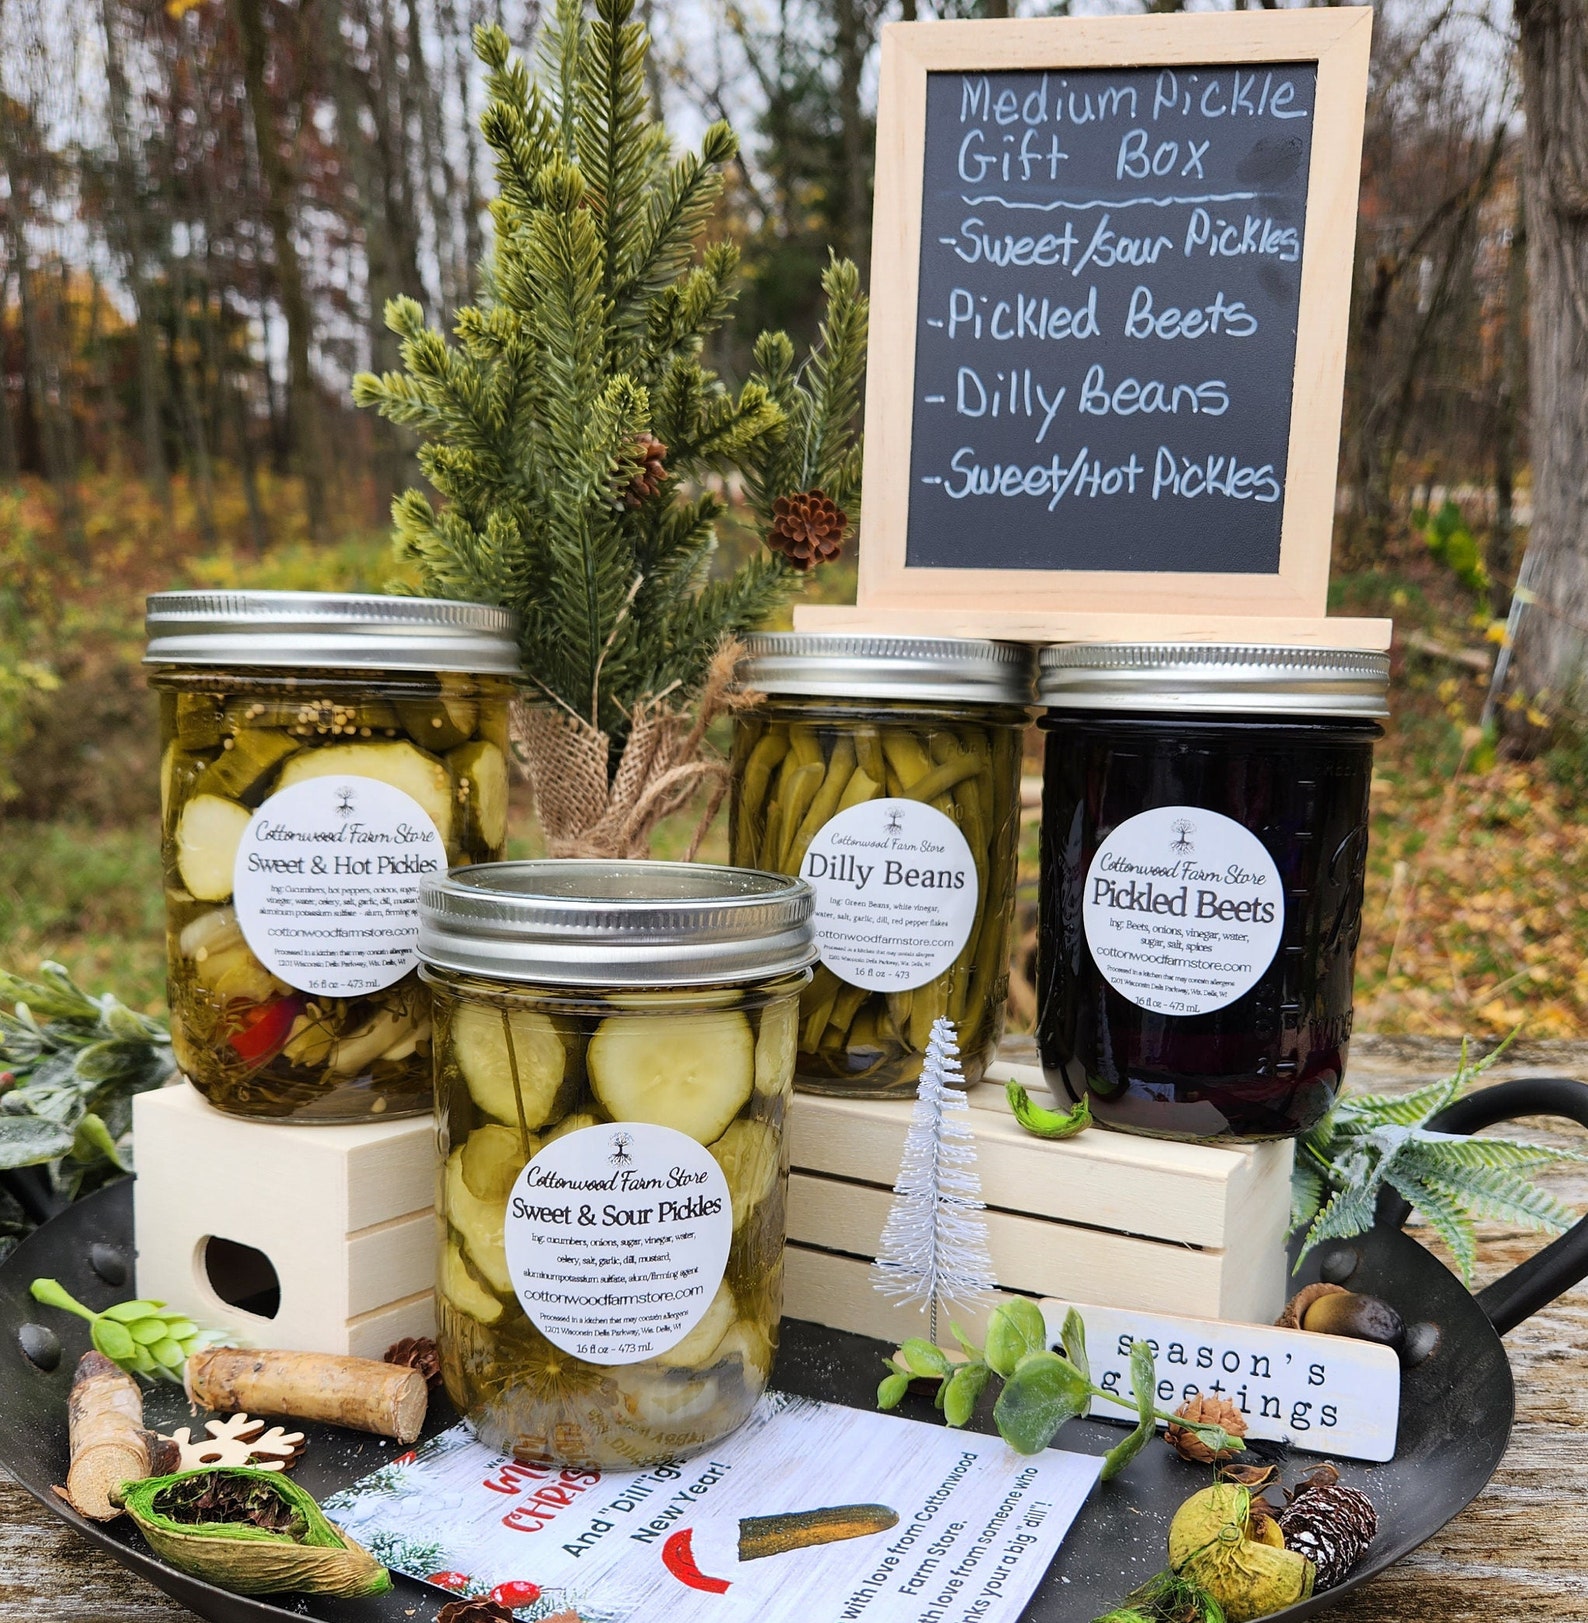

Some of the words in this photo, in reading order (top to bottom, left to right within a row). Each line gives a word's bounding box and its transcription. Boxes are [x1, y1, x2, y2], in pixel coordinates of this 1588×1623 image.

[960, 73, 1137, 125] Medium
[1153, 69, 1308, 121] Pickle
[958, 128, 1070, 184] Gift
[1116, 128, 1210, 181] Box
[1184, 208, 1299, 263] Pickles
[1124, 285, 1258, 340] Beets
[1078, 364, 1230, 416] Beans
[1152, 446, 1281, 502] Pickles
[255, 820, 349, 843] Cottonwood
[349, 823, 393, 844] Farm
[394, 823, 435, 844] Store
[831, 832, 890, 850] Cottonwood
[891, 838, 918, 852] Farm
[919, 840, 945, 854] Store
[248, 852, 304, 874] Sweet
[310, 855, 328, 875] &
[334, 856, 372, 875] Hot
[378, 854, 437, 875] Pickles
[807, 852, 875, 891] Dilly
[883, 860, 965, 890] Beans
[1100, 852, 1181, 878] Cottonwood
[1181, 860, 1223, 882] Farm
[1224, 864, 1266, 886] Store
[844, 898, 867, 908] Green
[868, 900, 892, 911] Beans,
[893, 901, 912, 911] white
[913, 903, 940, 914] vinegar,
[1092, 877, 1188, 917] Pickled
[1195, 889, 1275, 924] Beets
[267, 926, 420, 939] cottonwoodfarmstore.com
[837, 912, 851, 922] salt,
[853, 914, 875, 925] garlic,
[876, 915, 890, 926] dill,
[891, 916, 904, 926] red
[905, 918, 929, 928] pepper
[929, 917, 949, 928] flakes
[1126, 920, 1151, 932] Beets,
[1152, 924, 1184, 938] onions,
[1185, 928, 1221, 942] vinegar,
[1222, 932, 1250, 943] water,
[1140, 937, 1166, 949] sugar,
[1167, 938, 1184, 952] salt,
[1186, 942, 1212, 953] spices
[1096, 946, 1252, 973] cottonwoodfarmstore.com
[309, 980, 320, 989] 16
[347, 980, 364, 989] 473
[855, 968, 866, 977] 16
[876, 970, 886, 978] oz
[895, 970, 910, 980] 473
[1135, 996, 1145, 1006] 16
[1169, 1001, 1185, 1012] 473
[527, 1165, 619, 1192] Cottonwood
[621, 1169, 666, 1193] Farm
[666, 1166, 709, 1189] Store
[512, 1197, 573, 1225] Sweet
[577, 1204, 597, 1227] &
[602, 1205, 655, 1227] Sour
[658, 1195, 722, 1223] Pickles
[546, 1236, 588, 1248] cucumbers,
[590, 1237, 619, 1248] onions,
[679, 1266, 699, 1278] agent
[523, 1284, 704, 1307] cottonwoodfarmstore.com
[577, 1343, 588, 1354] 16
[598, 1345, 609, 1354] oz
[618, 1343, 636, 1354] 473
[638, 1342, 654, 1353] mL
[1100, 1370, 1338, 1431] geetings
[483, 1457, 506, 1470] We
[1013, 1467, 1039, 1496] who
[630, 1504, 685, 1544] New
[671, 1461, 732, 1503] Year!
[978, 1491, 1022, 1546] someone
[561, 1517, 615, 1558] And
[840, 1586, 877, 1622] with
[869, 1557, 900, 1589] love
[887, 1522, 926, 1556] from
[915, 1451, 979, 1522] Cottonwood
[1007, 1534, 1038, 1557] big
[899, 1560, 940, 1596] Farm
[927, 1520, 968, 1557] Store.
[950, 1545, 987, 1578] from
[1002, 1551, 1018, 1565] a
[937, 1574, 964, 1604] love
[981, 1562, 1011, 1599] your
